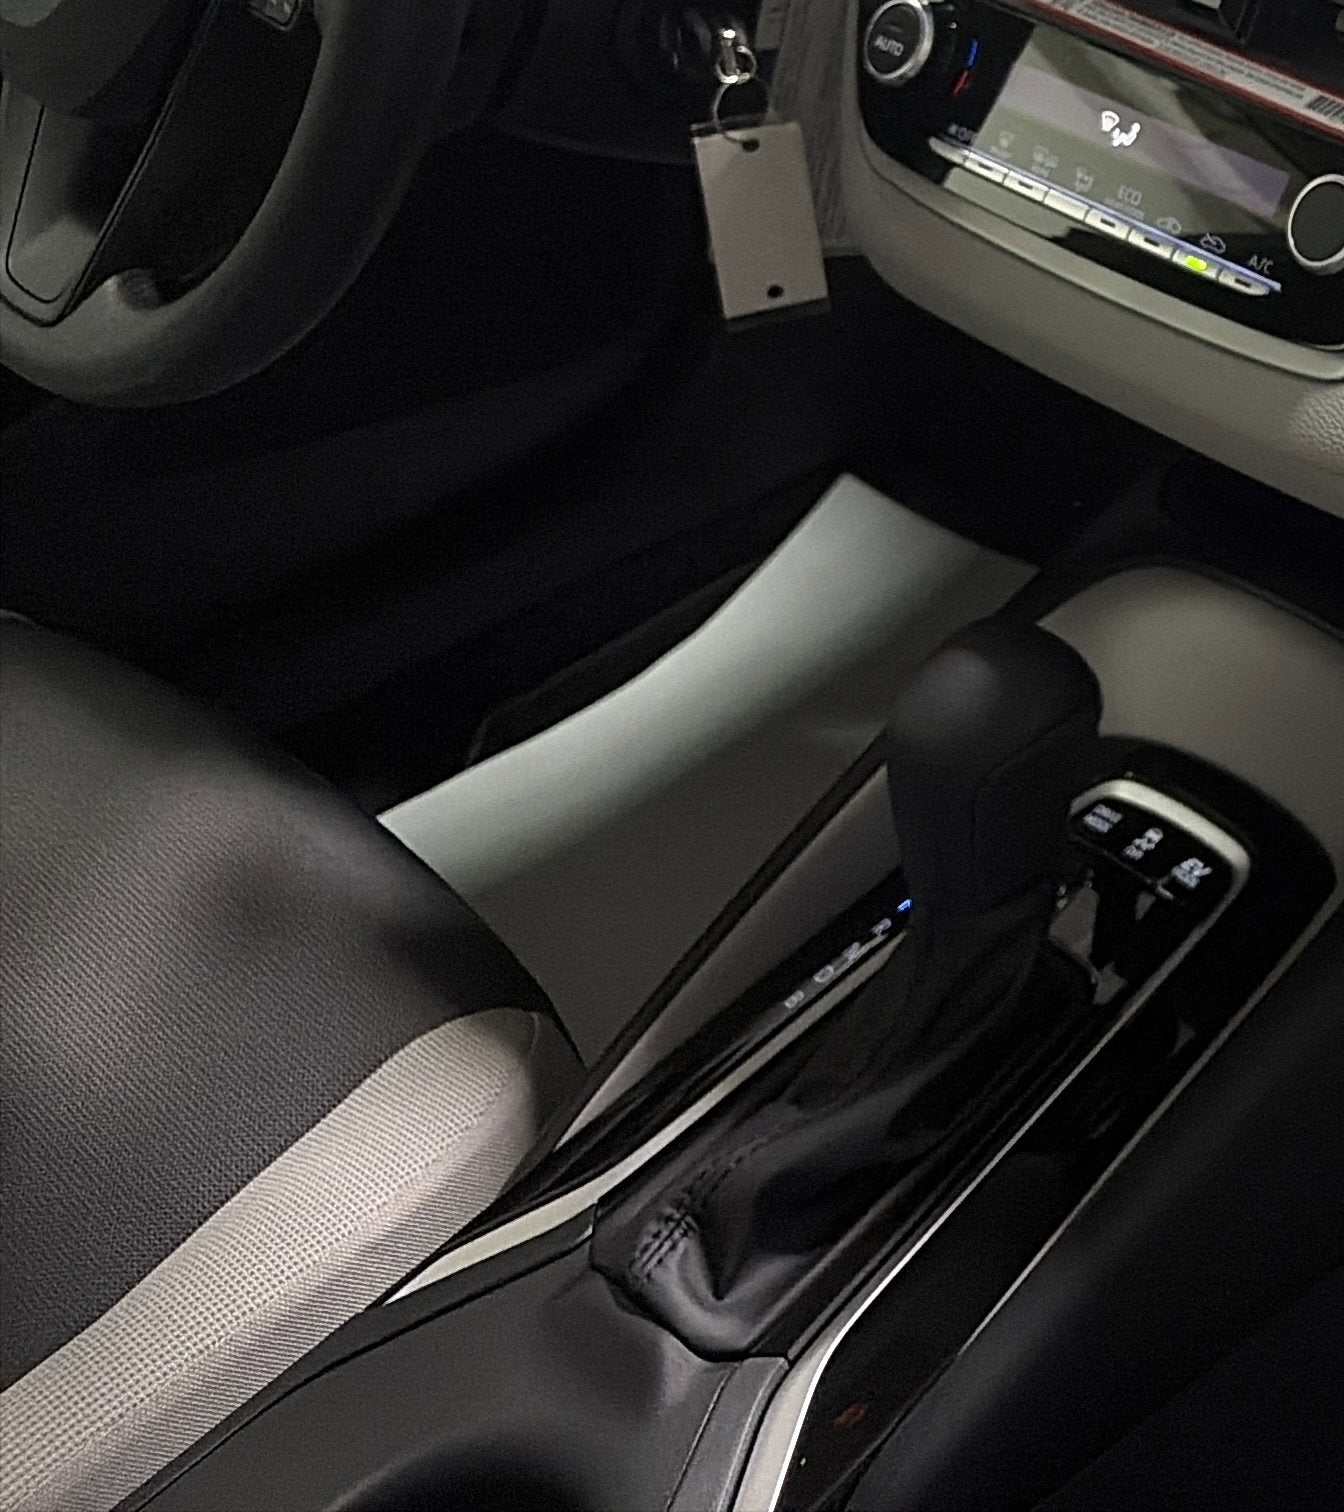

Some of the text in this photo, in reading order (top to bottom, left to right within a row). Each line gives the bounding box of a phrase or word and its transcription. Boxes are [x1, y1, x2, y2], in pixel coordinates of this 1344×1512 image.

[874, 34, 904, 57] AUTO
[1118, 185, 1142, 206] ECO
[1249, 254, 1274, 274] A/C
